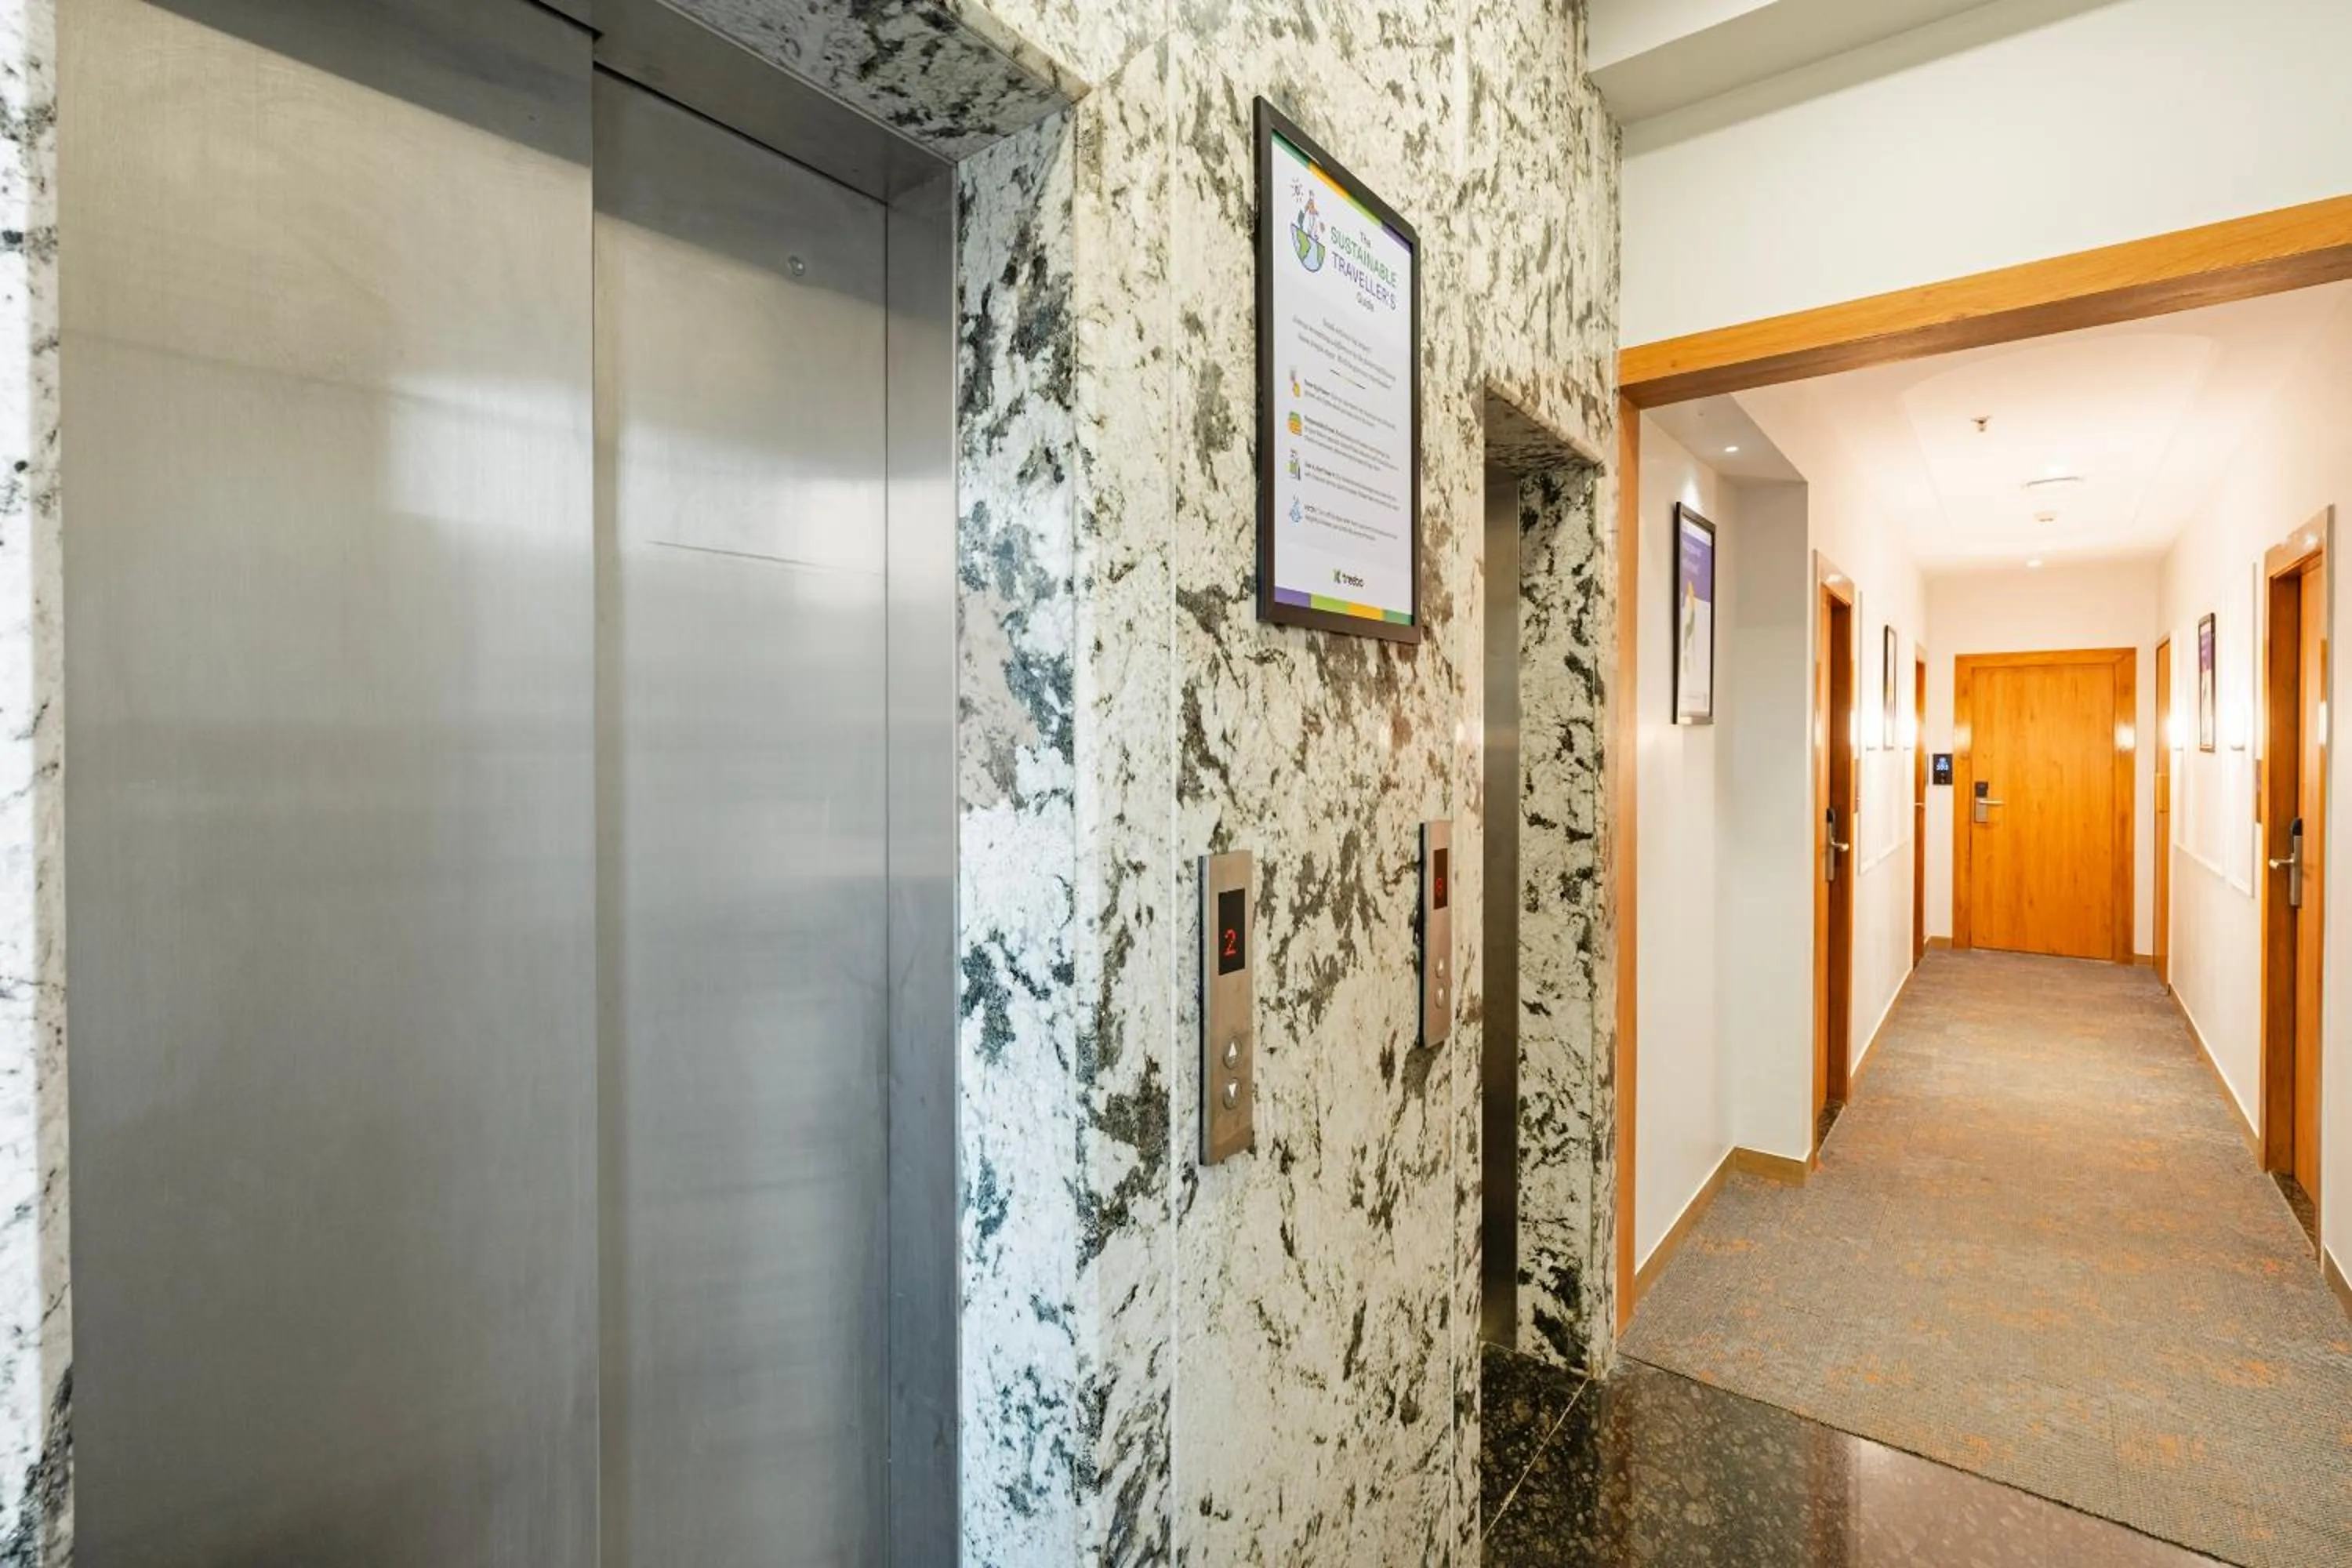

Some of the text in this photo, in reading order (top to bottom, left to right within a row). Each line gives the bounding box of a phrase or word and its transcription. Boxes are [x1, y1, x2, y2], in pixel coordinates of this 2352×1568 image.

[1330, 226, 1397, 288] SUSTAINABLE
[1359, 232, 1371, 248] The
[1332, 251, 1396, 310] TRAVELLER'S
[1224, 929, 1236, 956] 2
